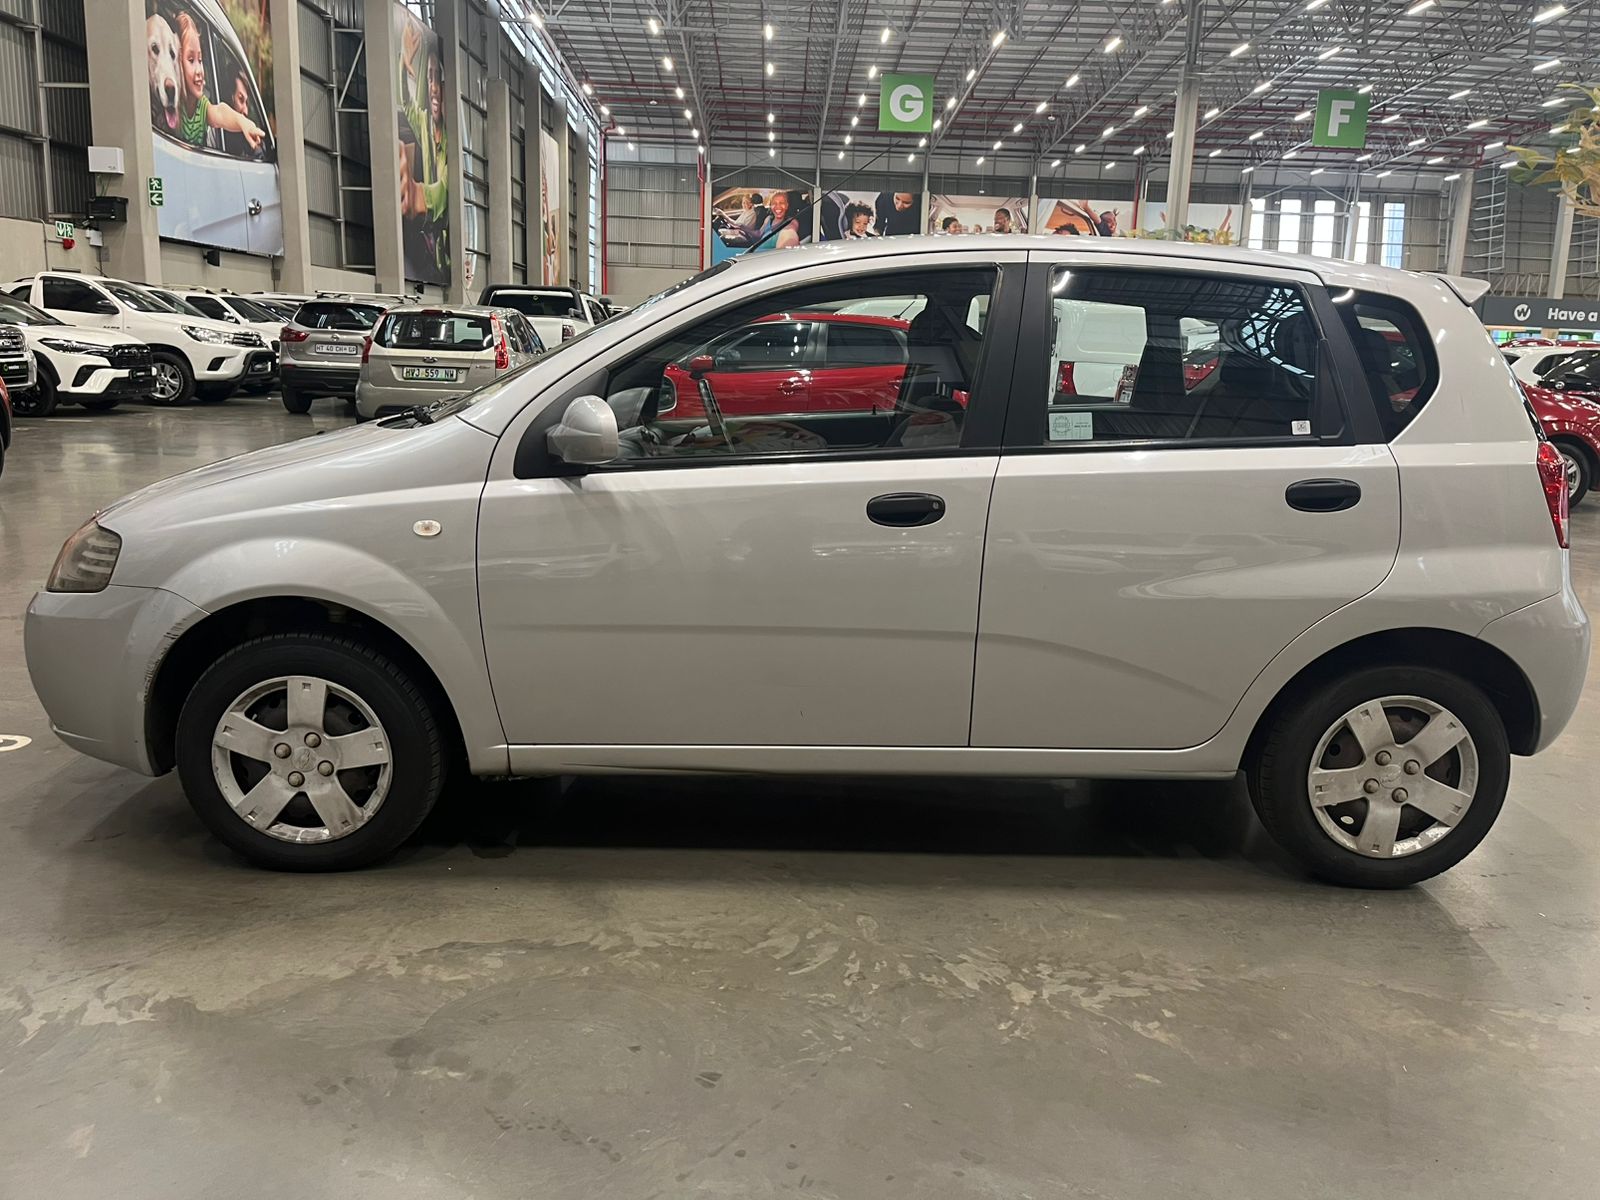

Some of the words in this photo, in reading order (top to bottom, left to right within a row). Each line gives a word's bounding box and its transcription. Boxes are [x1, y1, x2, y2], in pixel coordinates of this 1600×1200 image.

[890, 84, 924, 123] G
[1327, 99, 1356, 137] F
[1547, 307, 1586, 321] Have
[1588, 311, 1598, 322] a
[424, 368, 439, 378] 559
[444, 368, 454, 378] NW
